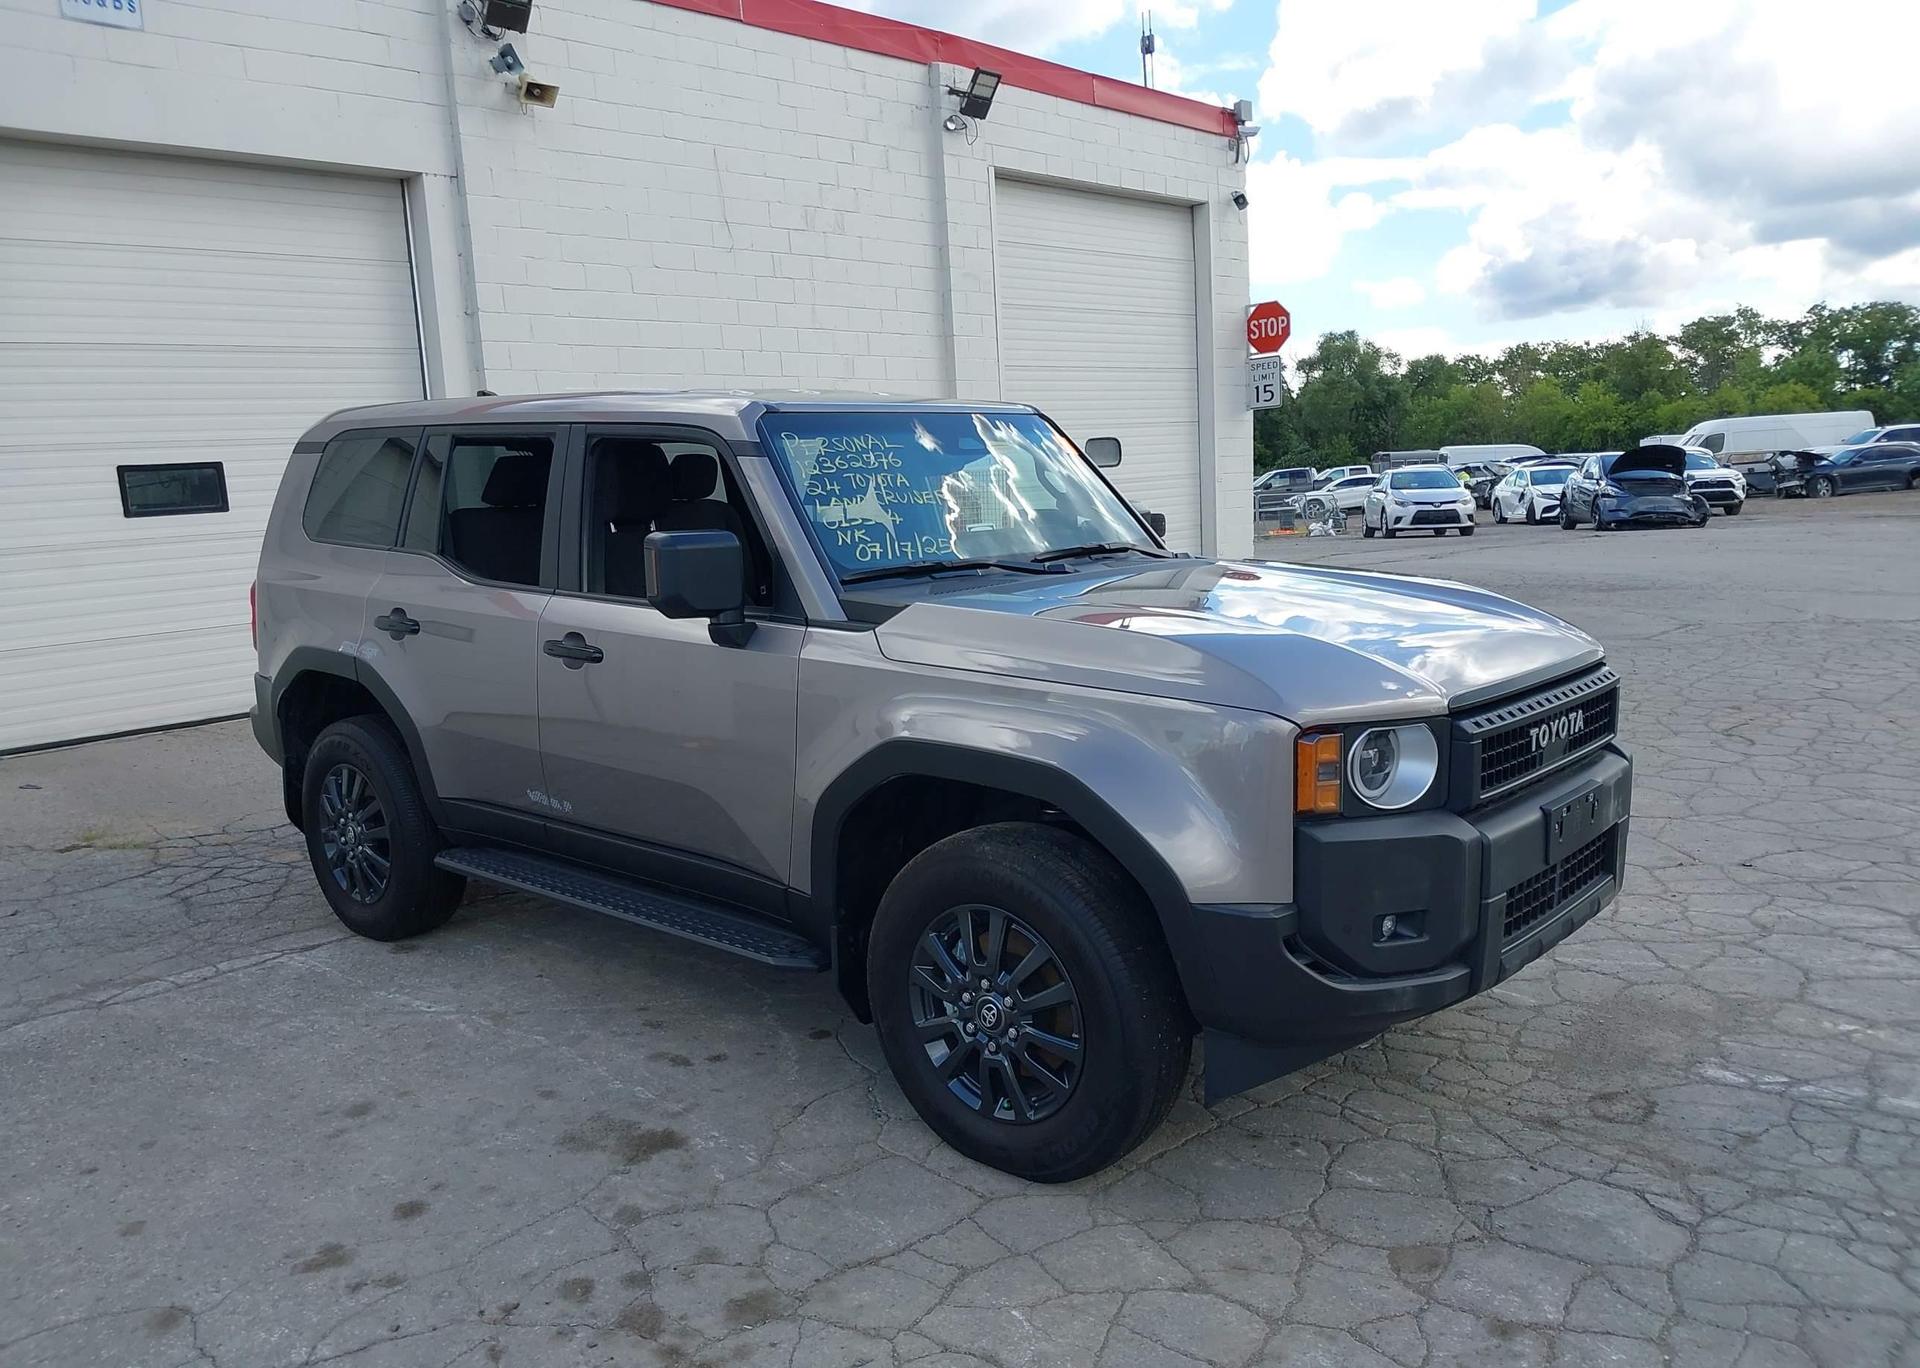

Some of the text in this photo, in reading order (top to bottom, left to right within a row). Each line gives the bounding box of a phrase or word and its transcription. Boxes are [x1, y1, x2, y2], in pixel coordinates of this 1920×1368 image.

[1249, 316, 1287, 339] STOP
[1250, 361, 1278, 372] SPEED
[1253, 372, 1275, 382] LIMIT
[1254, 383, 1275, 403] 15
[781, 432, 904, 457] PERSONAL
[803, 472, 911, 496] 24 TOYOTA
[838, 528, 871, 546] NK
[856, 531, 953, 561] 07/17/25
[1530, 709, 1584, 752] TOYOTA
